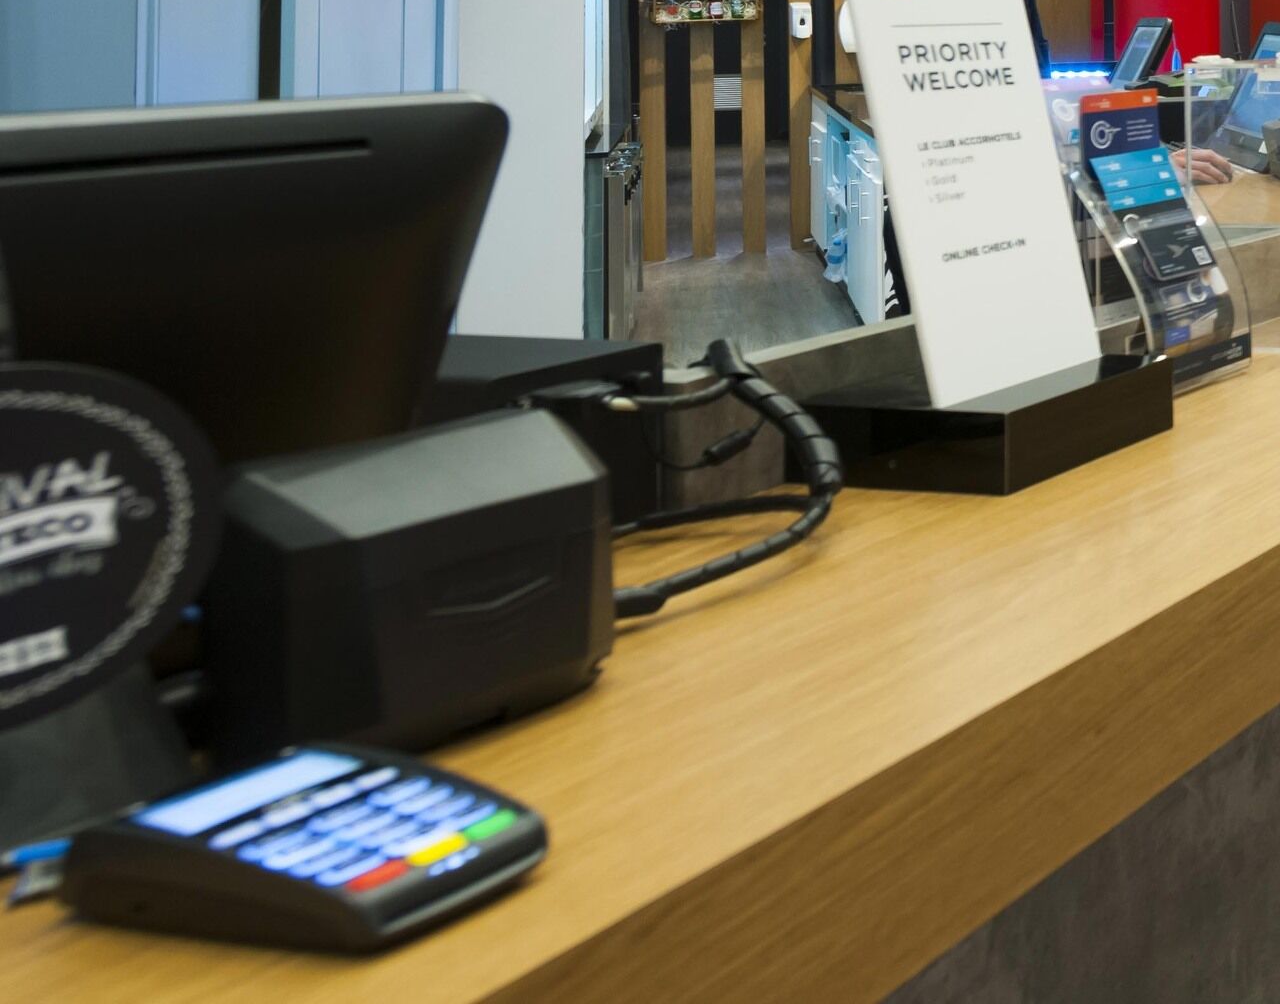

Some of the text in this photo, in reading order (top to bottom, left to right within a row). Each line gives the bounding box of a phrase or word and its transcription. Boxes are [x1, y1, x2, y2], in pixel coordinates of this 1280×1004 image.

[898, 41, 1007, 64] PRIORITY
[903, 67, 1015, 92] WELCOME
[931, 139, 956, 150] CLUB
[958, 131, 1022, 146] ACCORHOTELS
[941, 238, 1026, 262] ONLINE CHECK-IN
